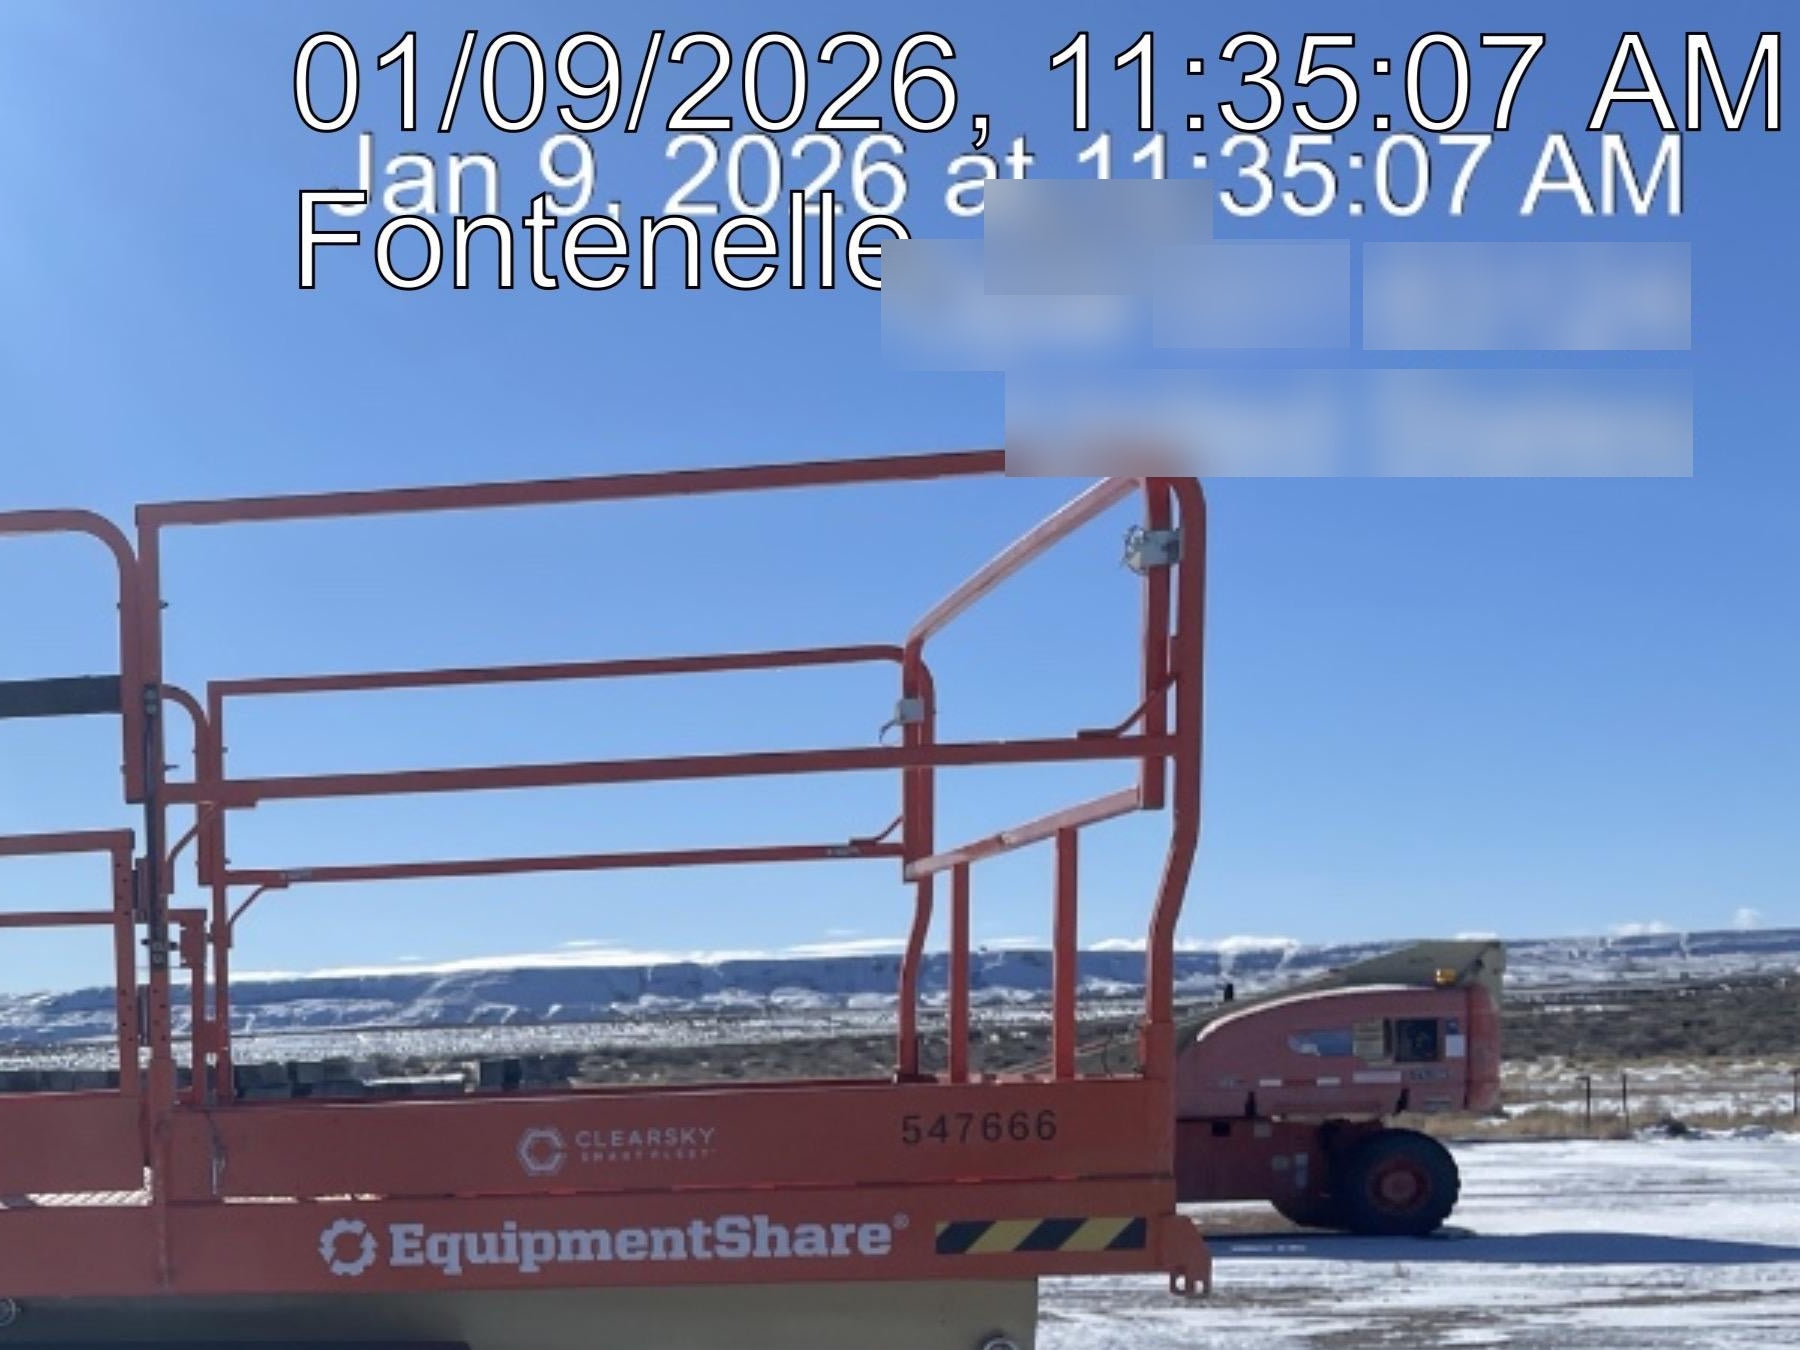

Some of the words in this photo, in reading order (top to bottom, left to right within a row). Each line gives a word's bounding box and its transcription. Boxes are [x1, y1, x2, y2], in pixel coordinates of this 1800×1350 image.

[575, 1127, 715, 1148] CLEARSKY
[902, 1109, 1057, 1145] 547666
[389, 1214, 893, 1276] EquipmentShare
